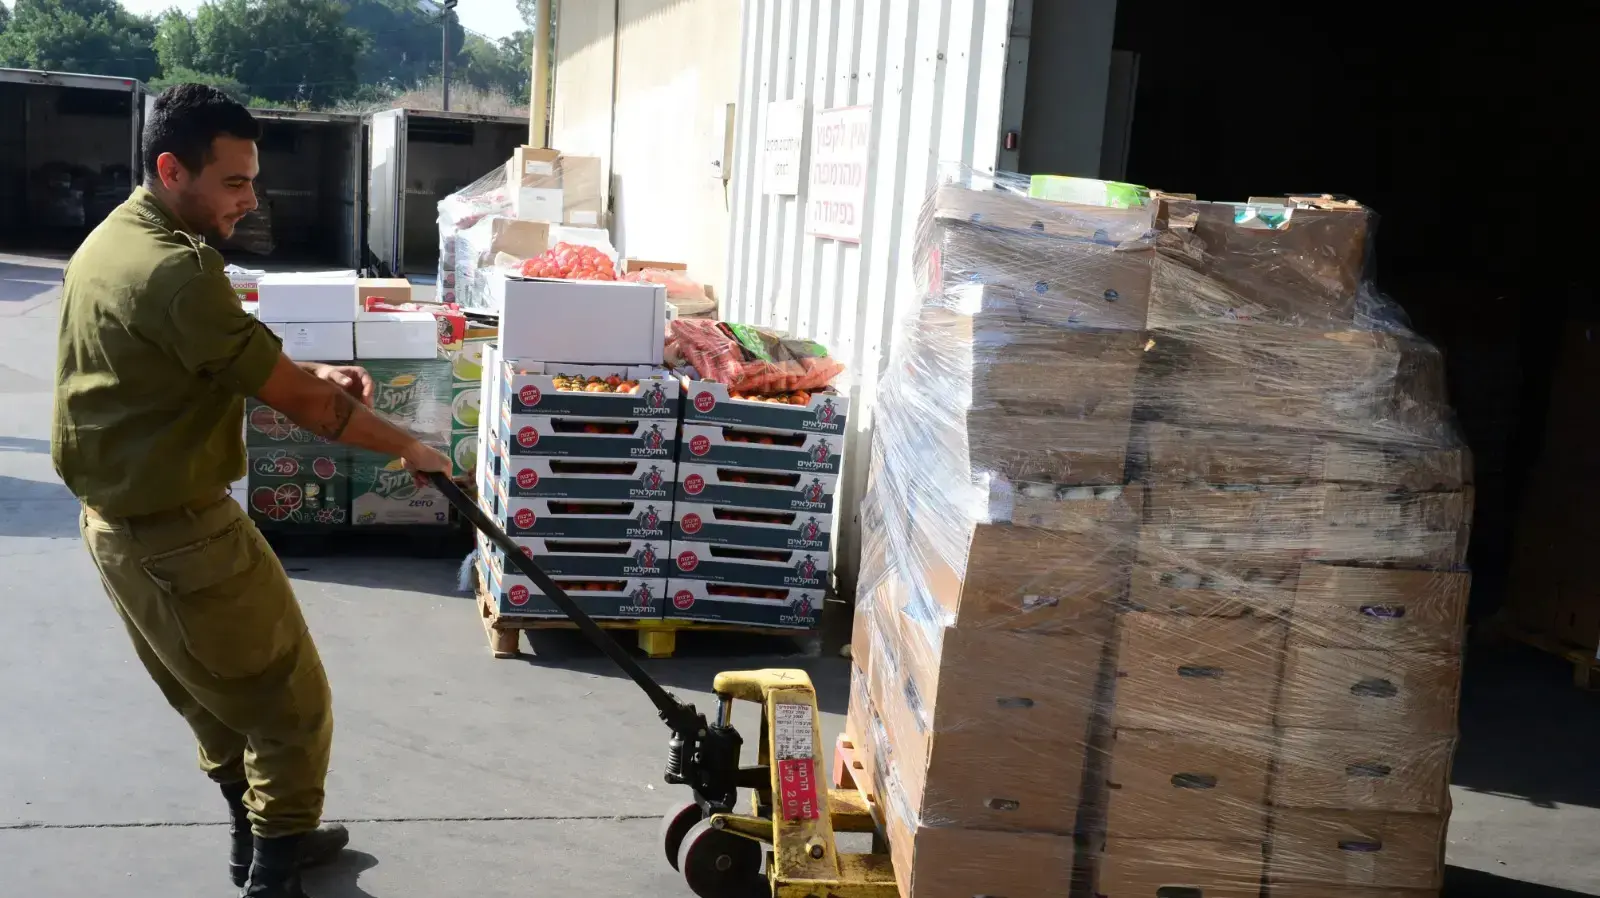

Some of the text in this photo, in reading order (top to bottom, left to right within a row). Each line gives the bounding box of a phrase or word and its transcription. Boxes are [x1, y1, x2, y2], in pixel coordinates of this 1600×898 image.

[816, 118, 846, 154] לקפוץ
[851, 122, 868, 150] אין
[814, 162, 862, 187] מהרמפה
[814, 200, 854, 226] בפקודה
[633, 406, 670, 414] החקלאים
[802, 420, 838, 430] החקלאים
[630, 446, 668, 455] החקלאים
[798, 460, 833, 469] החקלאים
[629, 488, 666, 496] החקלאים
[791, 500, 826, 508] החקלאים
[434, 512, 446, 520] 12
[626, 528, 663, 536] החקלאים
[787, 538, 822, 546] החקלאים
[784, 576, 819, 585] החקלאים
[780, 614, 815, 623] החקלאים
